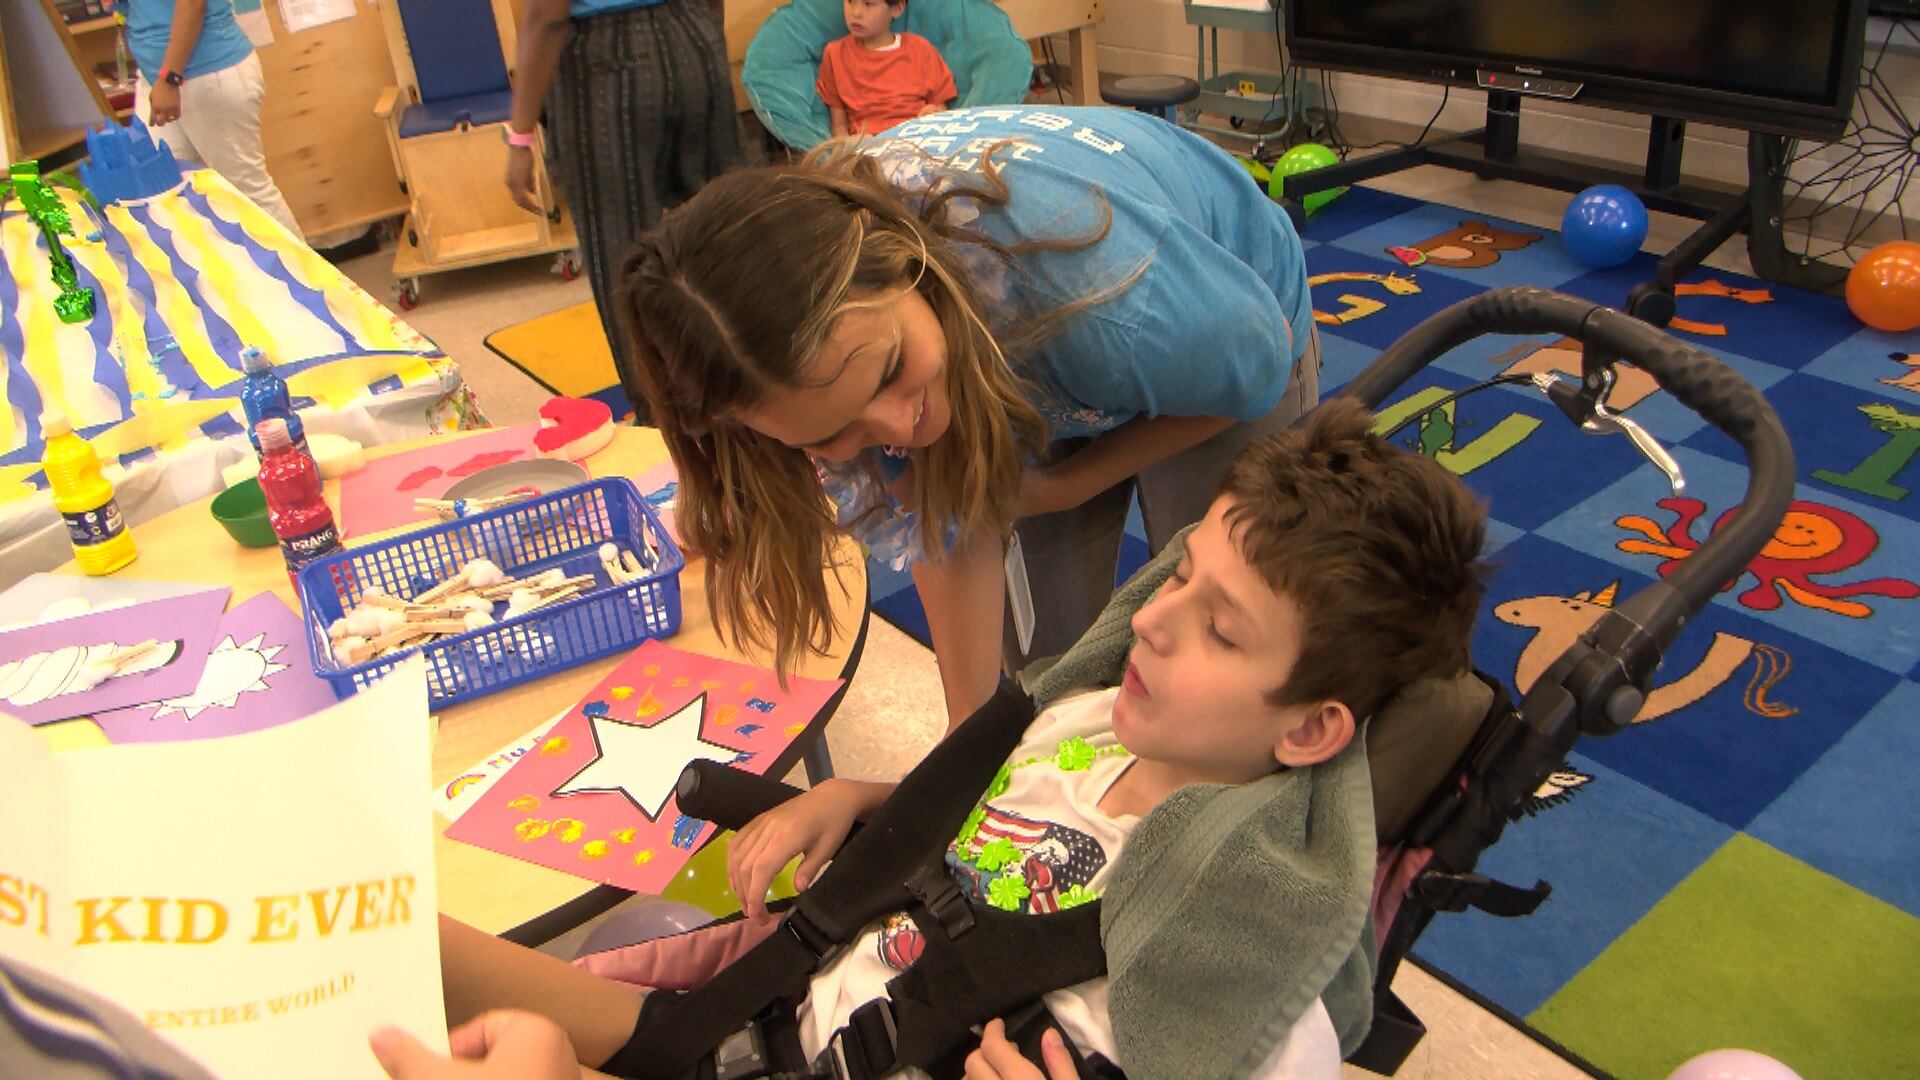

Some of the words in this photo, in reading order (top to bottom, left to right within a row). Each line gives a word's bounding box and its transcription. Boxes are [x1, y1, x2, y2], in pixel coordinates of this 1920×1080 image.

[291, 528, 333, 552] PRANG
[73, 896, 230, 946] KID
[249, 873, 416, 944] EVER
[145, 1002, 260, 1029] ENTIRE
[266, 971, 356, 1018] WORLD
